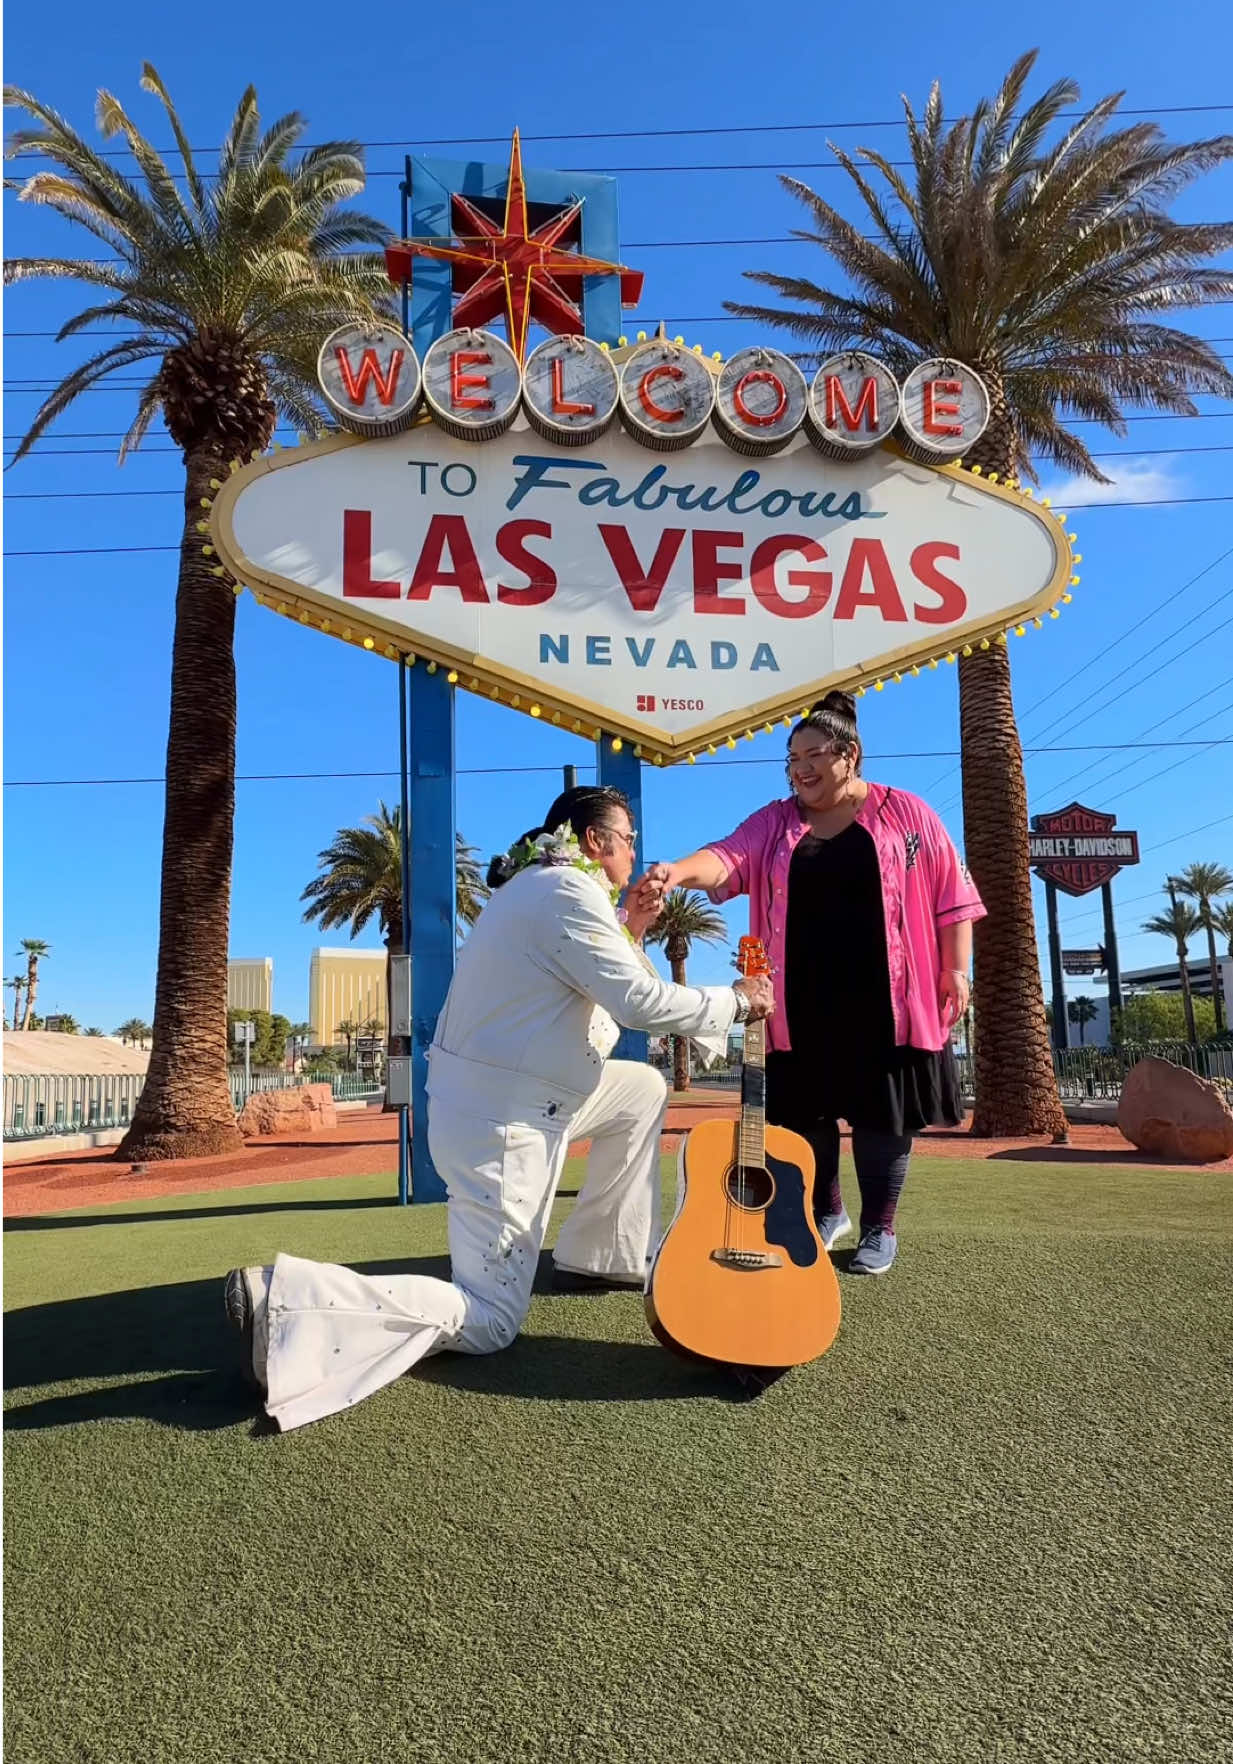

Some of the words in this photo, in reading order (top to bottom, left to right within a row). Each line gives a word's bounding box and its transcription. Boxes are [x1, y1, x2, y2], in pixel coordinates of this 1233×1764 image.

[336, 348, 964, 436] WELCOME
[408, 460, 477, 497] TO
[506, 455, 888, 523] Fabulous
[343, 510, 556, 607] LAS
[599, 525, 968, 625] VEGAS
[539, 632, 780, 673] NEVADA
[661, 698, 704, 711] YESCO
[1049, 811, 1106, 832] MOTOR
